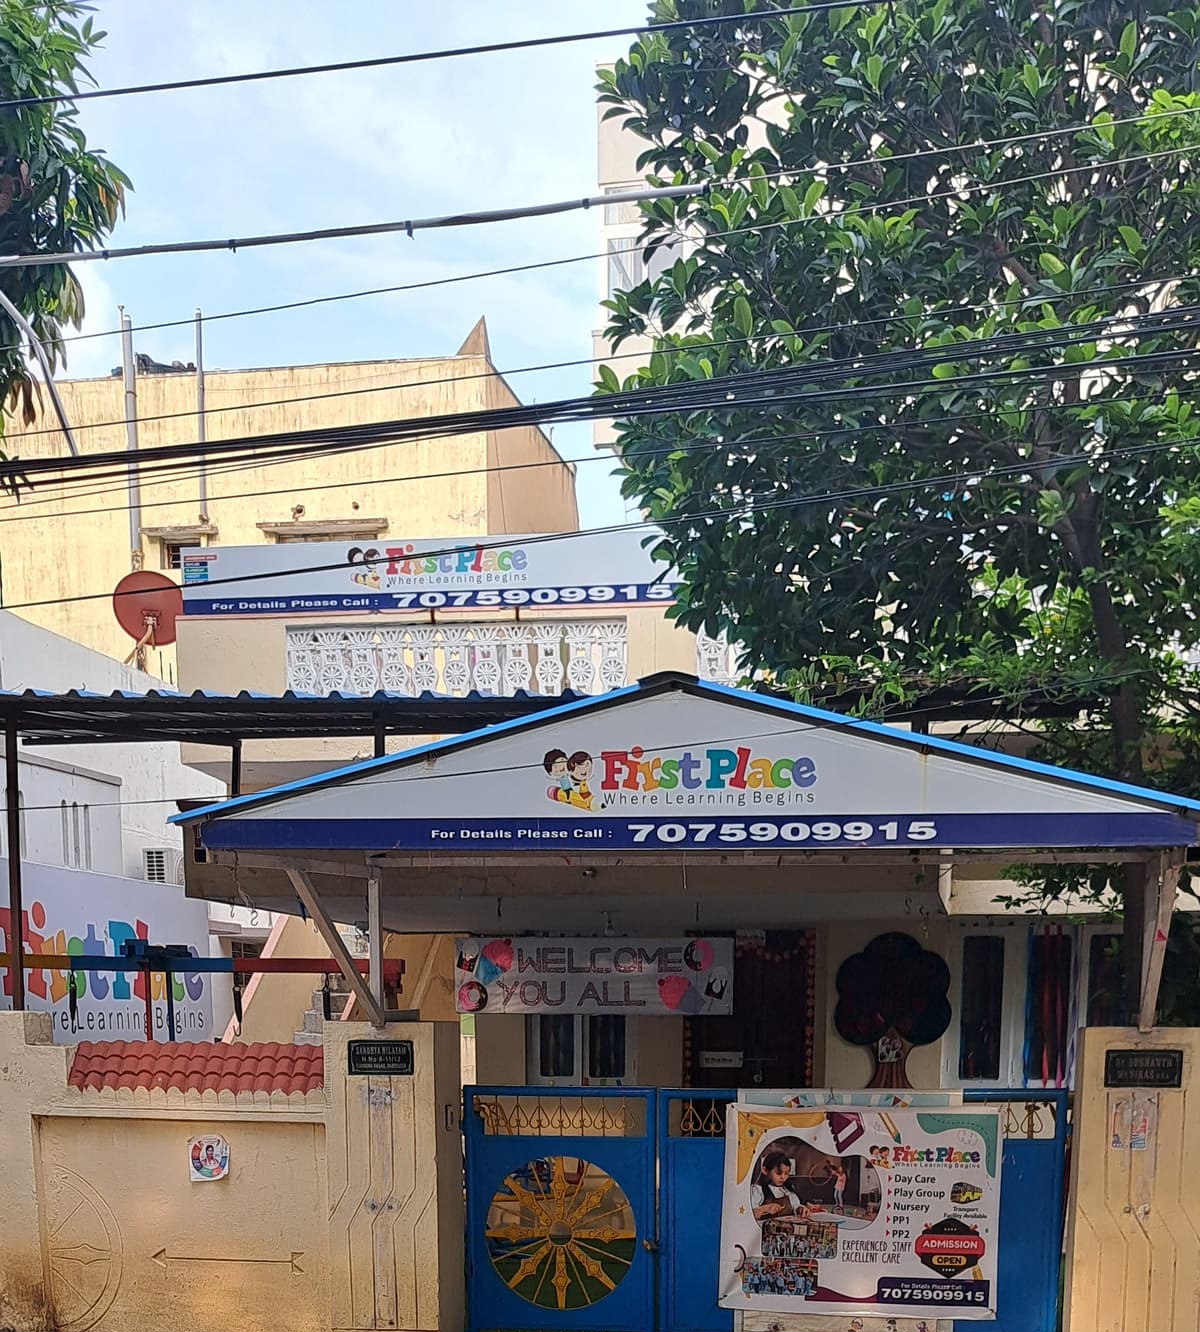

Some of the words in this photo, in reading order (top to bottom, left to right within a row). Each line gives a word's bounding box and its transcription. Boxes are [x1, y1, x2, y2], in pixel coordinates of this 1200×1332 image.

[385, 544, 452, 576] First
[455, 544, 528, 573] Place
[388, 576, 425, 585] Where
[429, 574, 482, 585] Learning
[486, 573, 527, 583] Begins
[212, 602, 235, 610] For
[239, 601, 287, 610] Details
[291, 600, 338, 608] Please
[343, 598, 369, 607] Call
[391, 584, 673, 608] 7075909915
[601, 746, 702, 792] First
[706, 746, 818, 791] Place
[604, 792, 659, 806] Where
[665, 791, 746, 807] Learning
[752, 790, 815, 806] Begins
[431, 829, 456, 839] For
[460, 829, 513, 839] Details
[517, 828, 568, 839] Please
[573, 828, 602, 839] Call
[627, 821, 938, 843] 7075909915
[517, 946, 684, 974] WELCOME
[496, 979, 567, 1007] YOU
[576, 980, 647, 1007] ALL
[156, 1006, 205, 1034] Bgins
[893, 1145, 934, 1162] First
[935, 1146, 981, 1163] Place
[894, 1174, 912, 1185] Day
[915, 1174, 936, 1184] Care
[894, 1188, 914, 1199] Play
[916, 1188, 946, 1199] Group
[893, 1202, 930, 1213] Nursery
[892, 1215, 910, 1225] PP1
[892, 1229, 910, 1239] PP2
[842, 1240, 888, 1252] EXPERIENCED
[892, 1241, 913, 1253] STAFF
[922, 1239, 978, 1249] ADMISSION
[841, 1252, 878, 1264] EXCELLENT
[882, 1252, 901, 1264] CARE
[936, 1255, 963, 1265] OPEN
[881, 1288, 985, 1302] 7075909915
